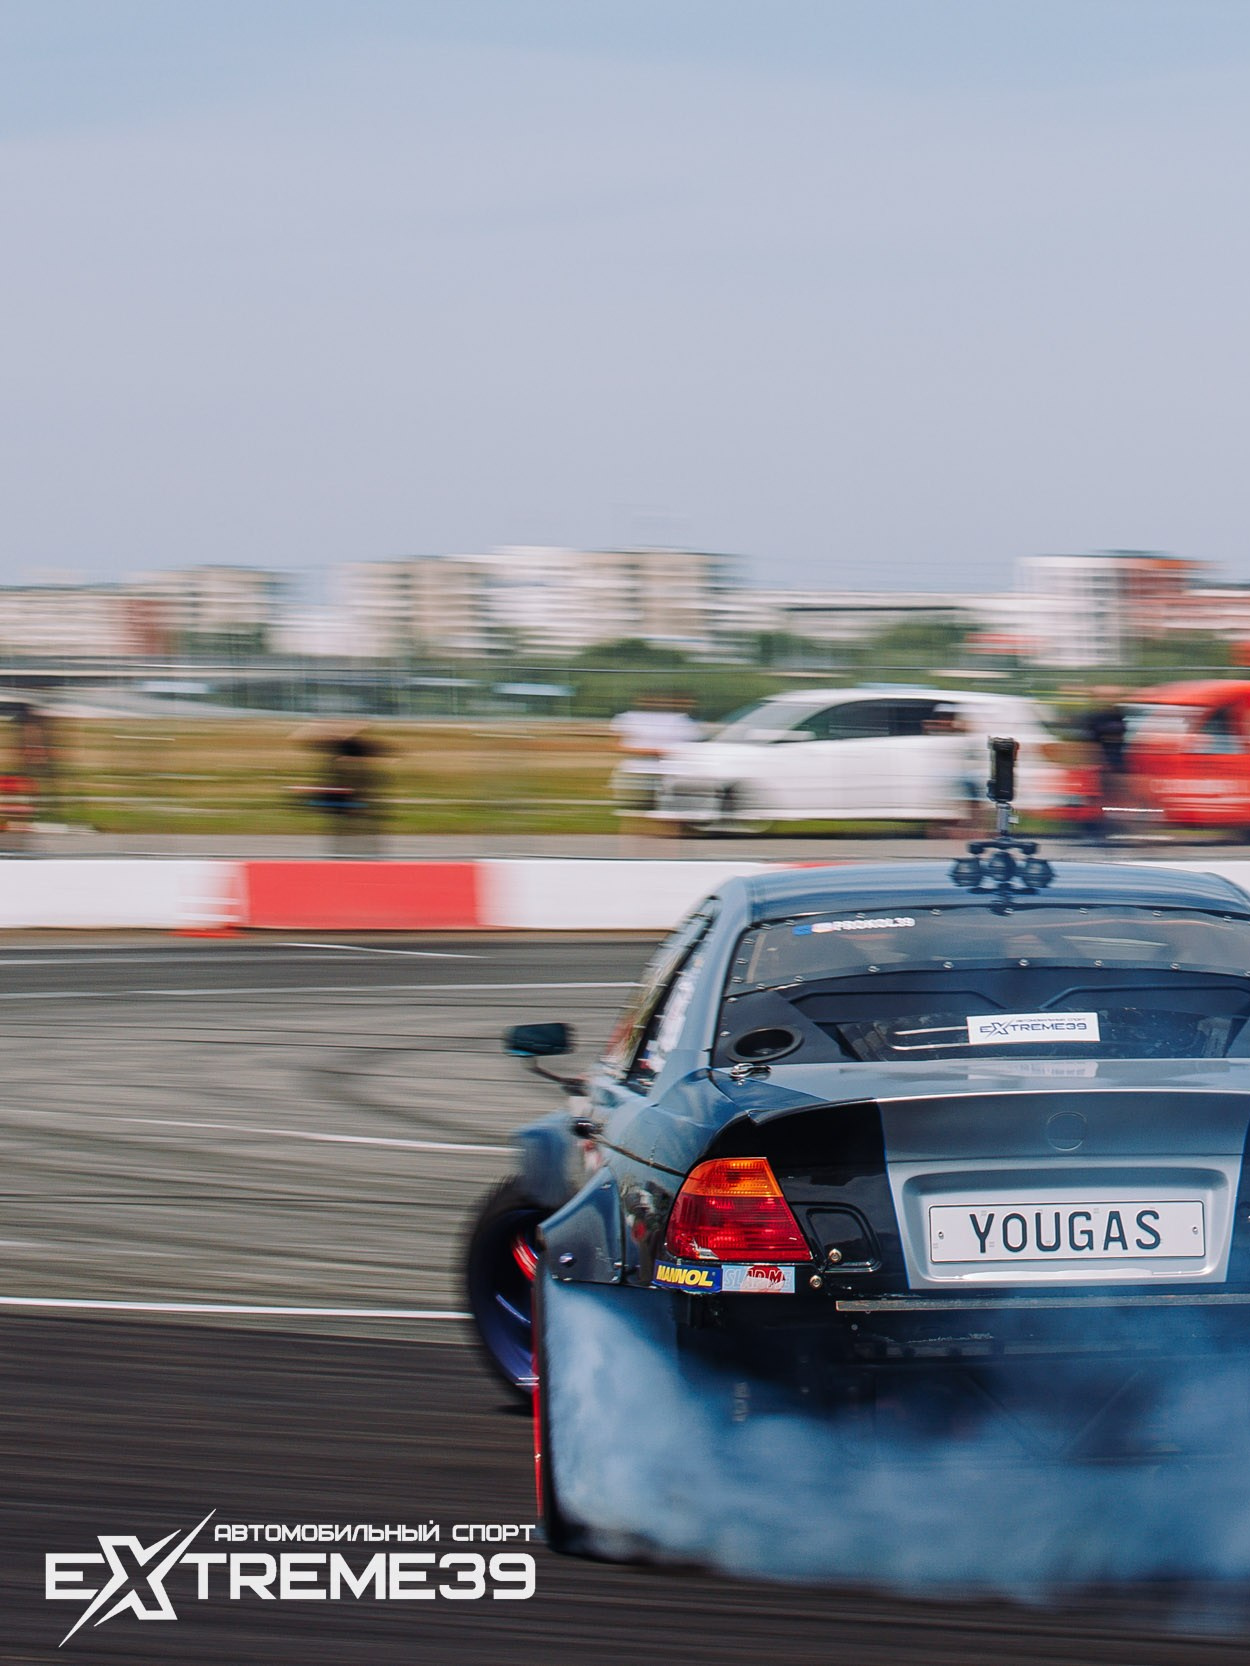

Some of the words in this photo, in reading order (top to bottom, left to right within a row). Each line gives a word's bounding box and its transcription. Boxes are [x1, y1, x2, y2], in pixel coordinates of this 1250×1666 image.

[979, 1018, 1087, 1038] EXTREME39
[969, 1209, 1161, 1254] YOUGAS
[656, 1264, 714, 1287] MANNOL
